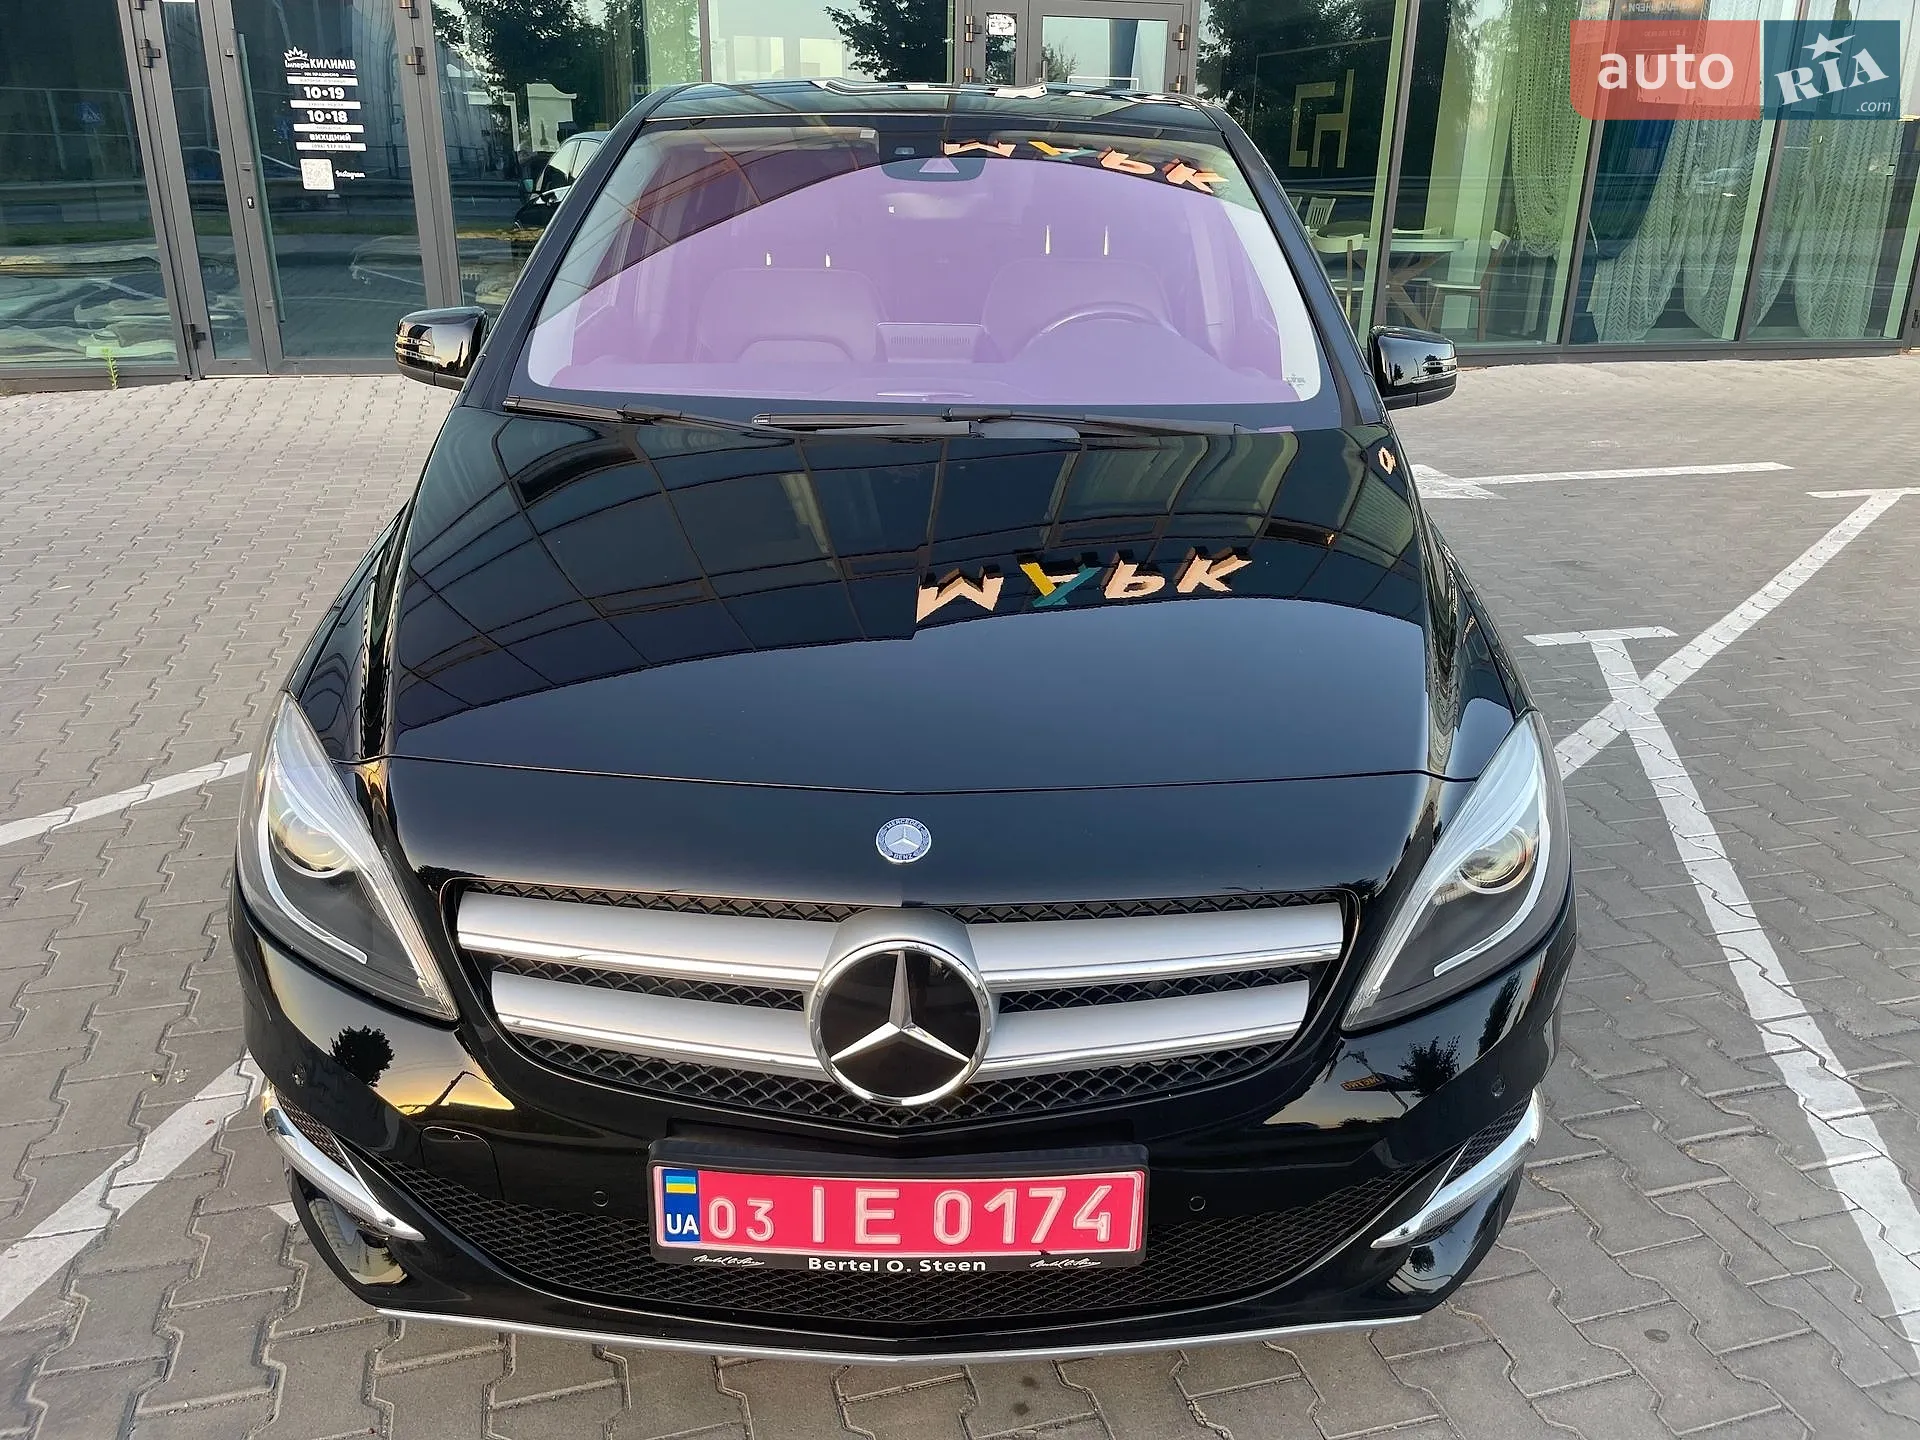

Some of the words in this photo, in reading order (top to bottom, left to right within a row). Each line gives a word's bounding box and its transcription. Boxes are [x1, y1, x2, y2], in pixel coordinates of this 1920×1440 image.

[310, 59, 356, 70] КИЛИМІВ
[666, 1212, 699, 1235] UA
[708, 1196, 774, 1242] 03
[812, 1185, 901, 1244] IE
[932, 1185, 1112, 1245] 0174
[808, 1257, 879, 1272] Bertel
[886, 1259, 911, 1272] O.
[919, 1259, 987, 1272] Steen
